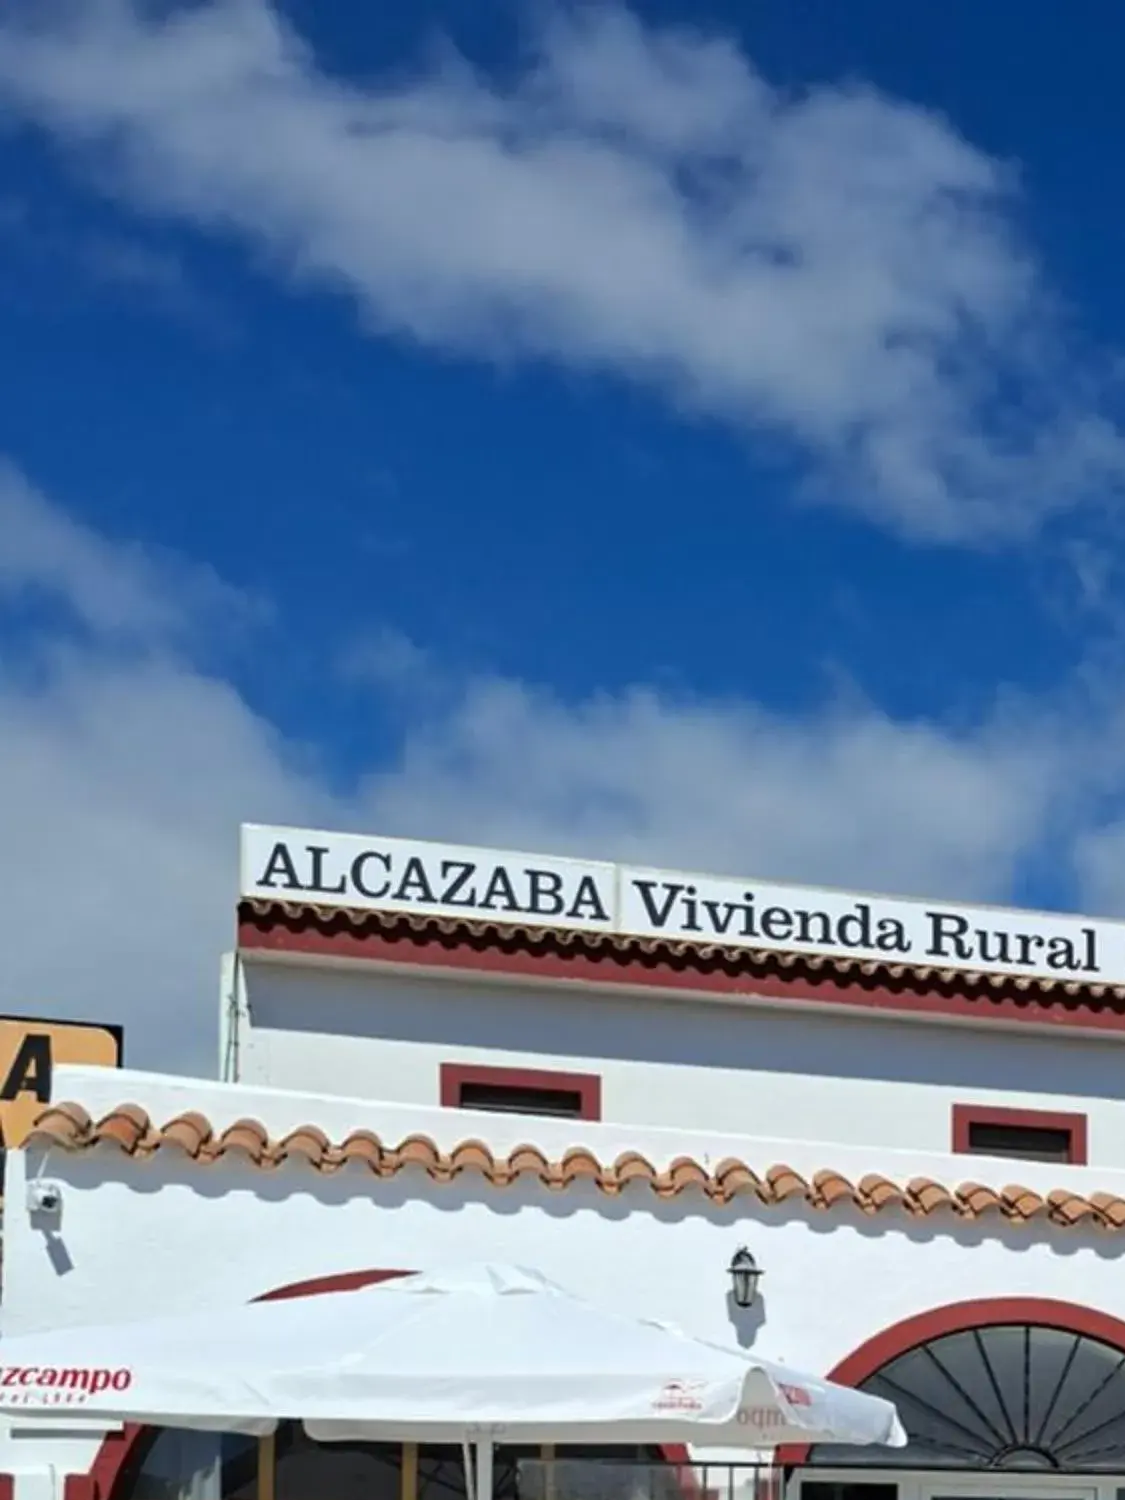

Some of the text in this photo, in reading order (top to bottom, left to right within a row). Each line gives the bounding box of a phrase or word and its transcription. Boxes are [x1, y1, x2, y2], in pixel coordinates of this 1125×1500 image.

[256, 842, 609, 921] ALCAZABA
[631, 879, 911, 954] Vivienda
[925, 911, 1100, 972] Rural
[0, 1033, 52, 1103] A
[0, 1366, 131, 1394] zcampo
